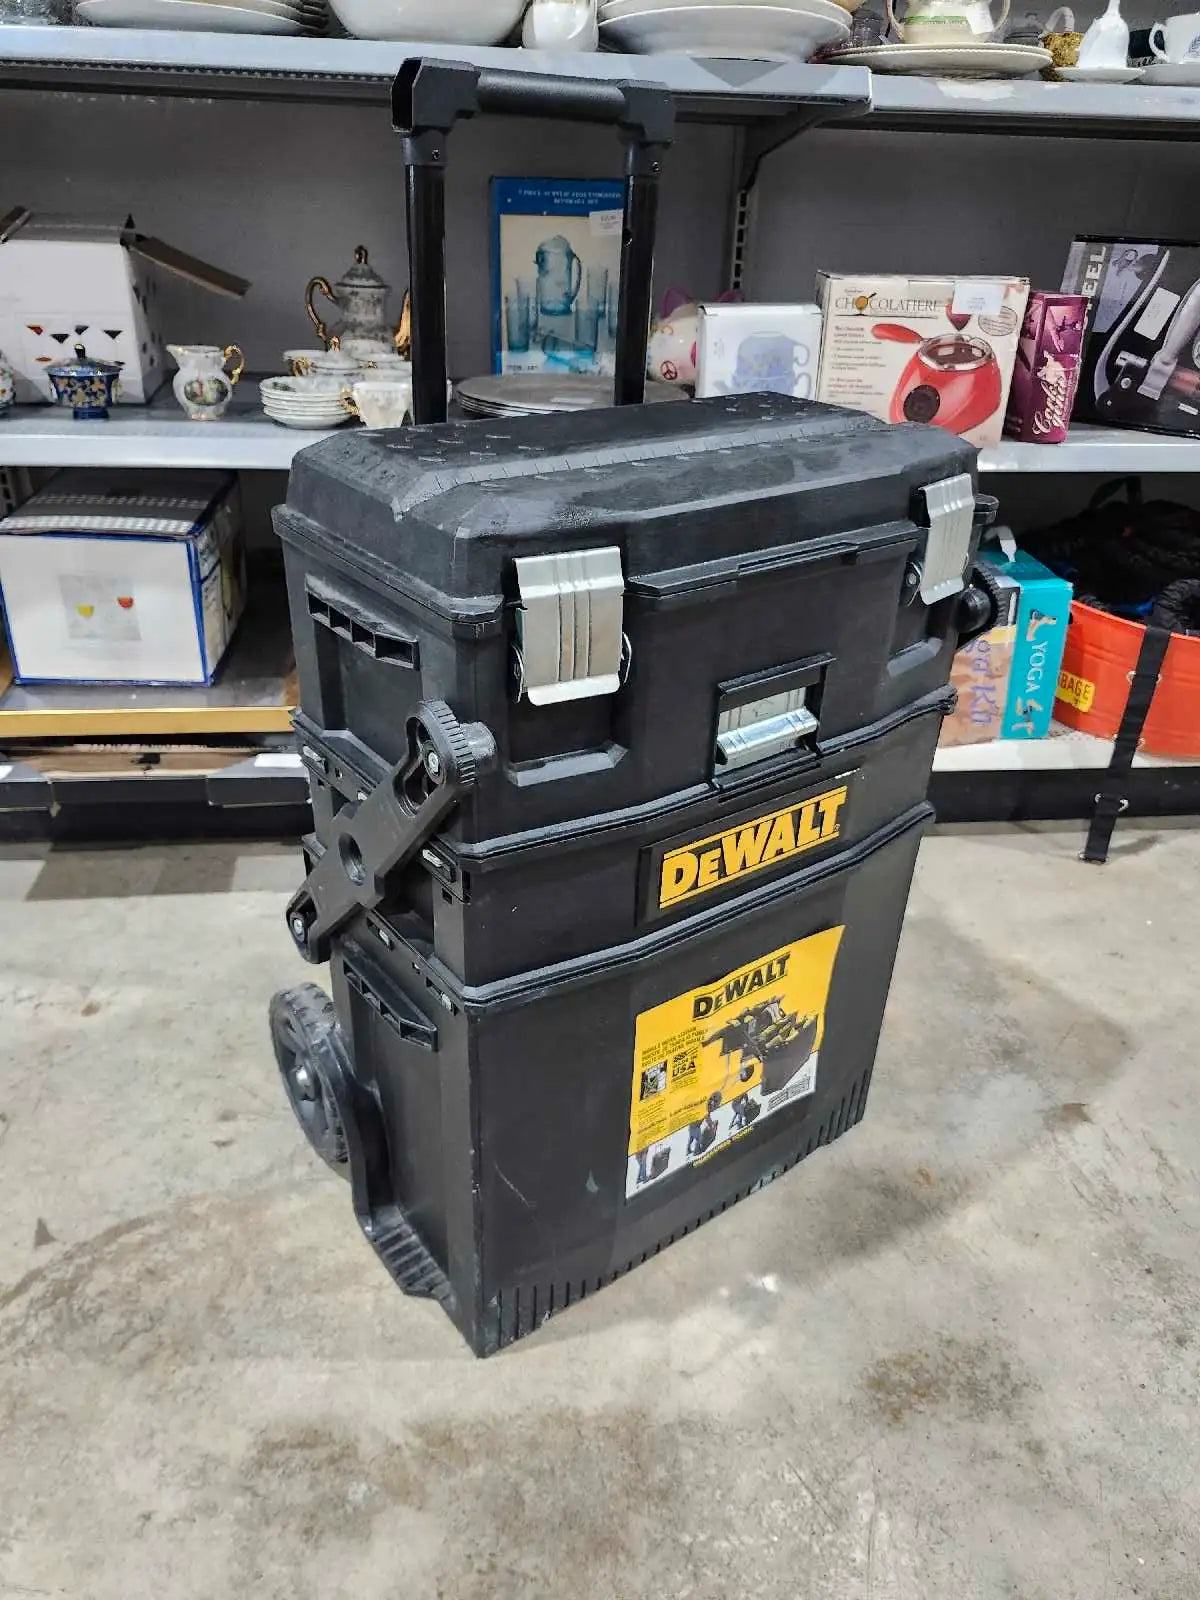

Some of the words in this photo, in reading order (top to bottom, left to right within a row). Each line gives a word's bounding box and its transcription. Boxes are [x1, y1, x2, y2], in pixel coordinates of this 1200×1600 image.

[1081, 246, 1106, 299] EEL
[1025, 641, 1049, 694] YOGA
[1060, 672, 1092, 699] BAGE
[660, 789, 847, 907] DEWALT
[692, 953, 790, 1019] DEWALT
[673, 1061, 696, 1077] USA
